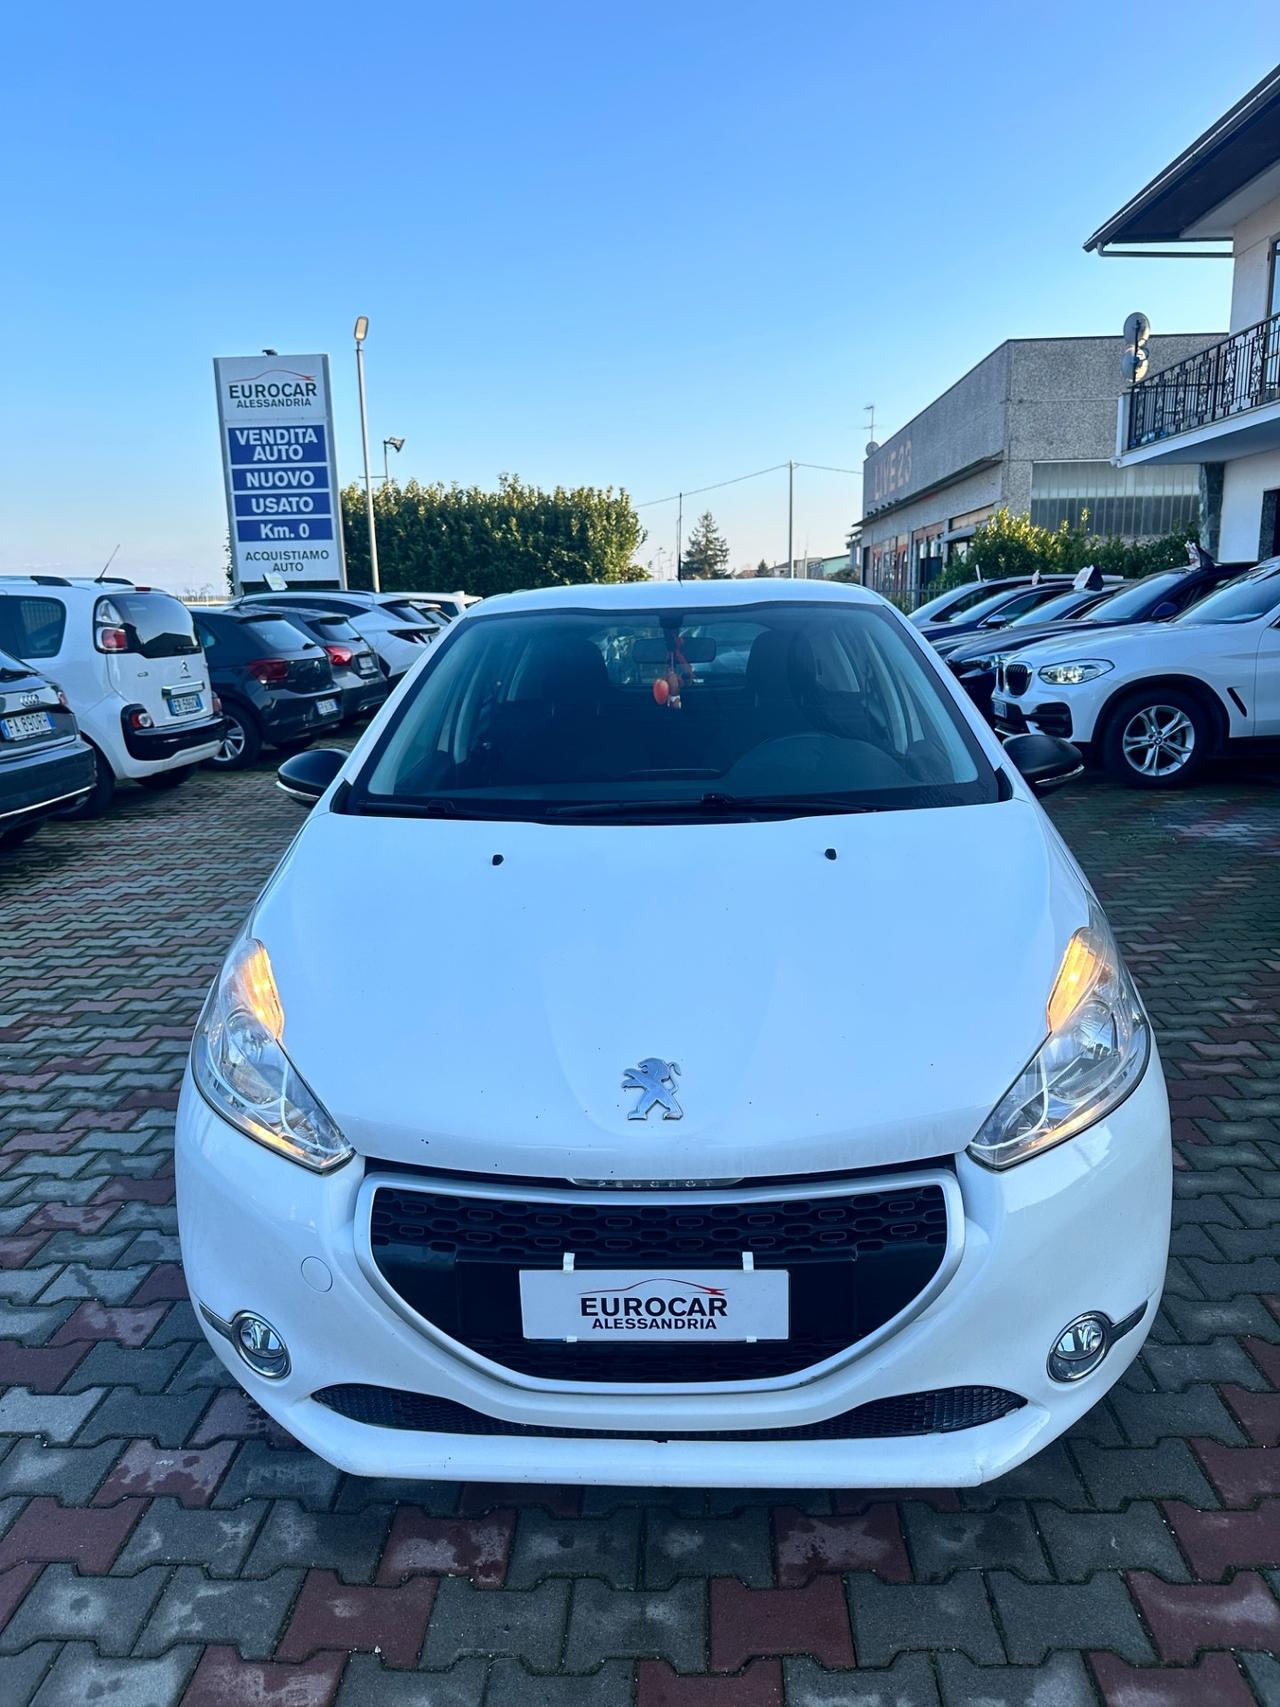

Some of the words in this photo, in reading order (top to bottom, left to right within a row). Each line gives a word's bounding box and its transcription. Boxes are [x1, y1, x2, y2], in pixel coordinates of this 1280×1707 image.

[229, 383, 317, 399] EUROCAR
[236, 397, 312, 408] ALESSANDRIA
[235, 427, 318, 446] VENDITA
[253, 444, 303, 461] AUTO
[246, 470, 315, 488] NUOVO
[251, 496, 314, 513] USATO
[260, 523, 295, 539] Km.
[299, 522, 310, 538] 0
[245, 549, 329, 562] ACQUISTIAMO
[272, 559, 304, 572] AUTO
[581, 1297, 727, 1317] EUROCAR
[592, 1318, 716, 1329] ALESSANDRIA
